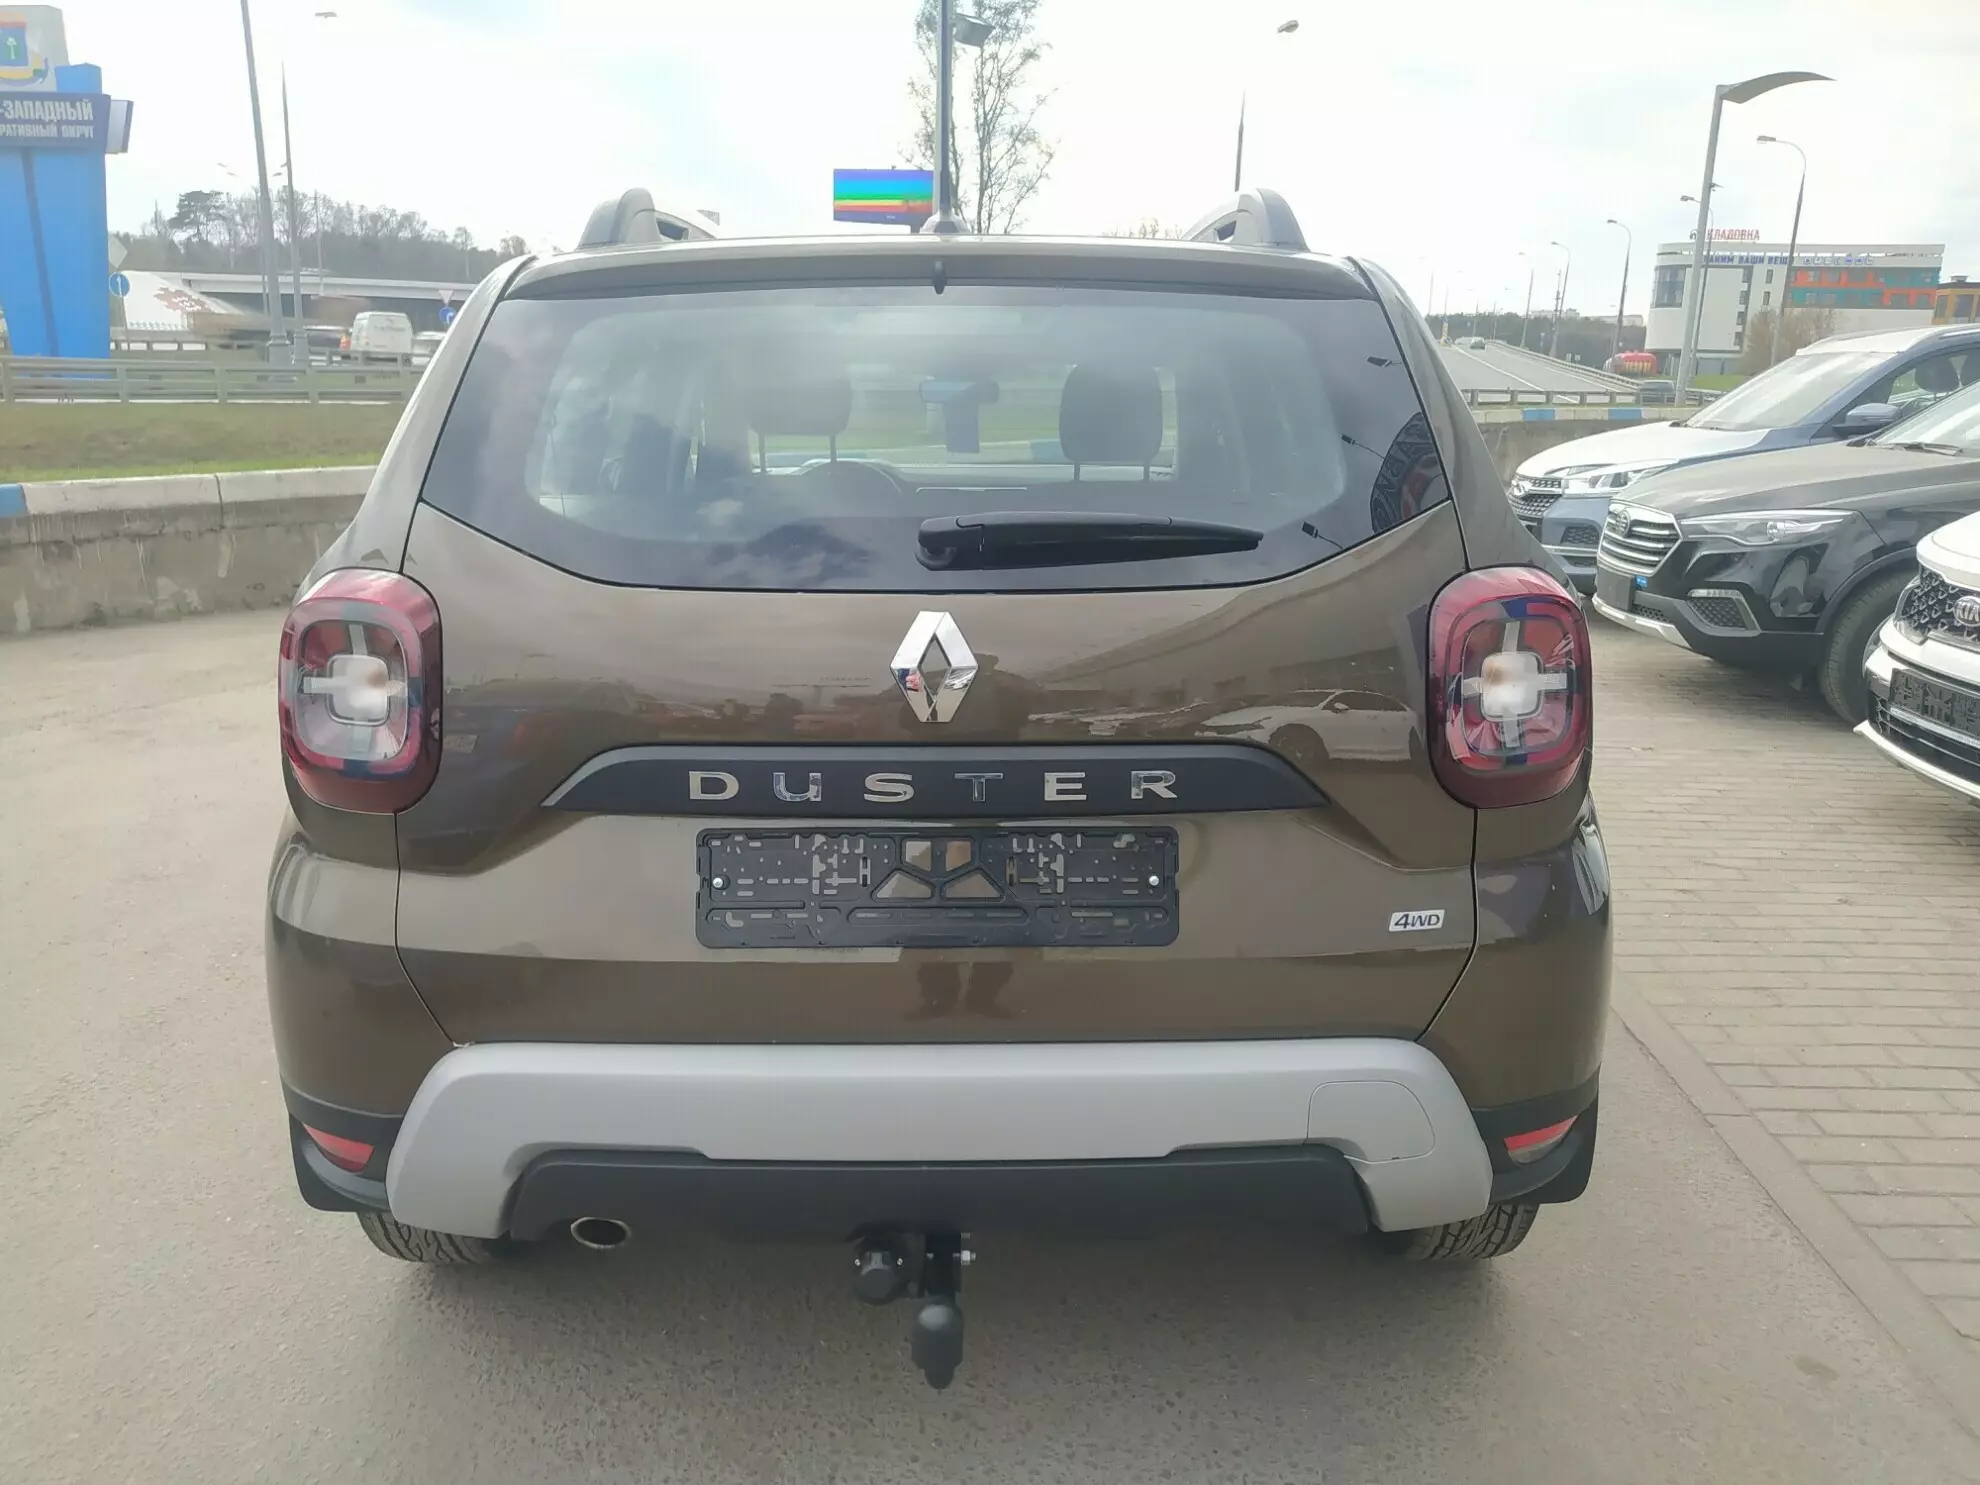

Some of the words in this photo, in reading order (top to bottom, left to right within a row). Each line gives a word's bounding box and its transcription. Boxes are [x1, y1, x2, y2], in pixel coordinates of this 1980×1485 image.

[61, 124, 94, 139] ОКРУГ
[688, 770, 1178, 803] DUSTER
[1394, 912, 1441, 929] 4WD
